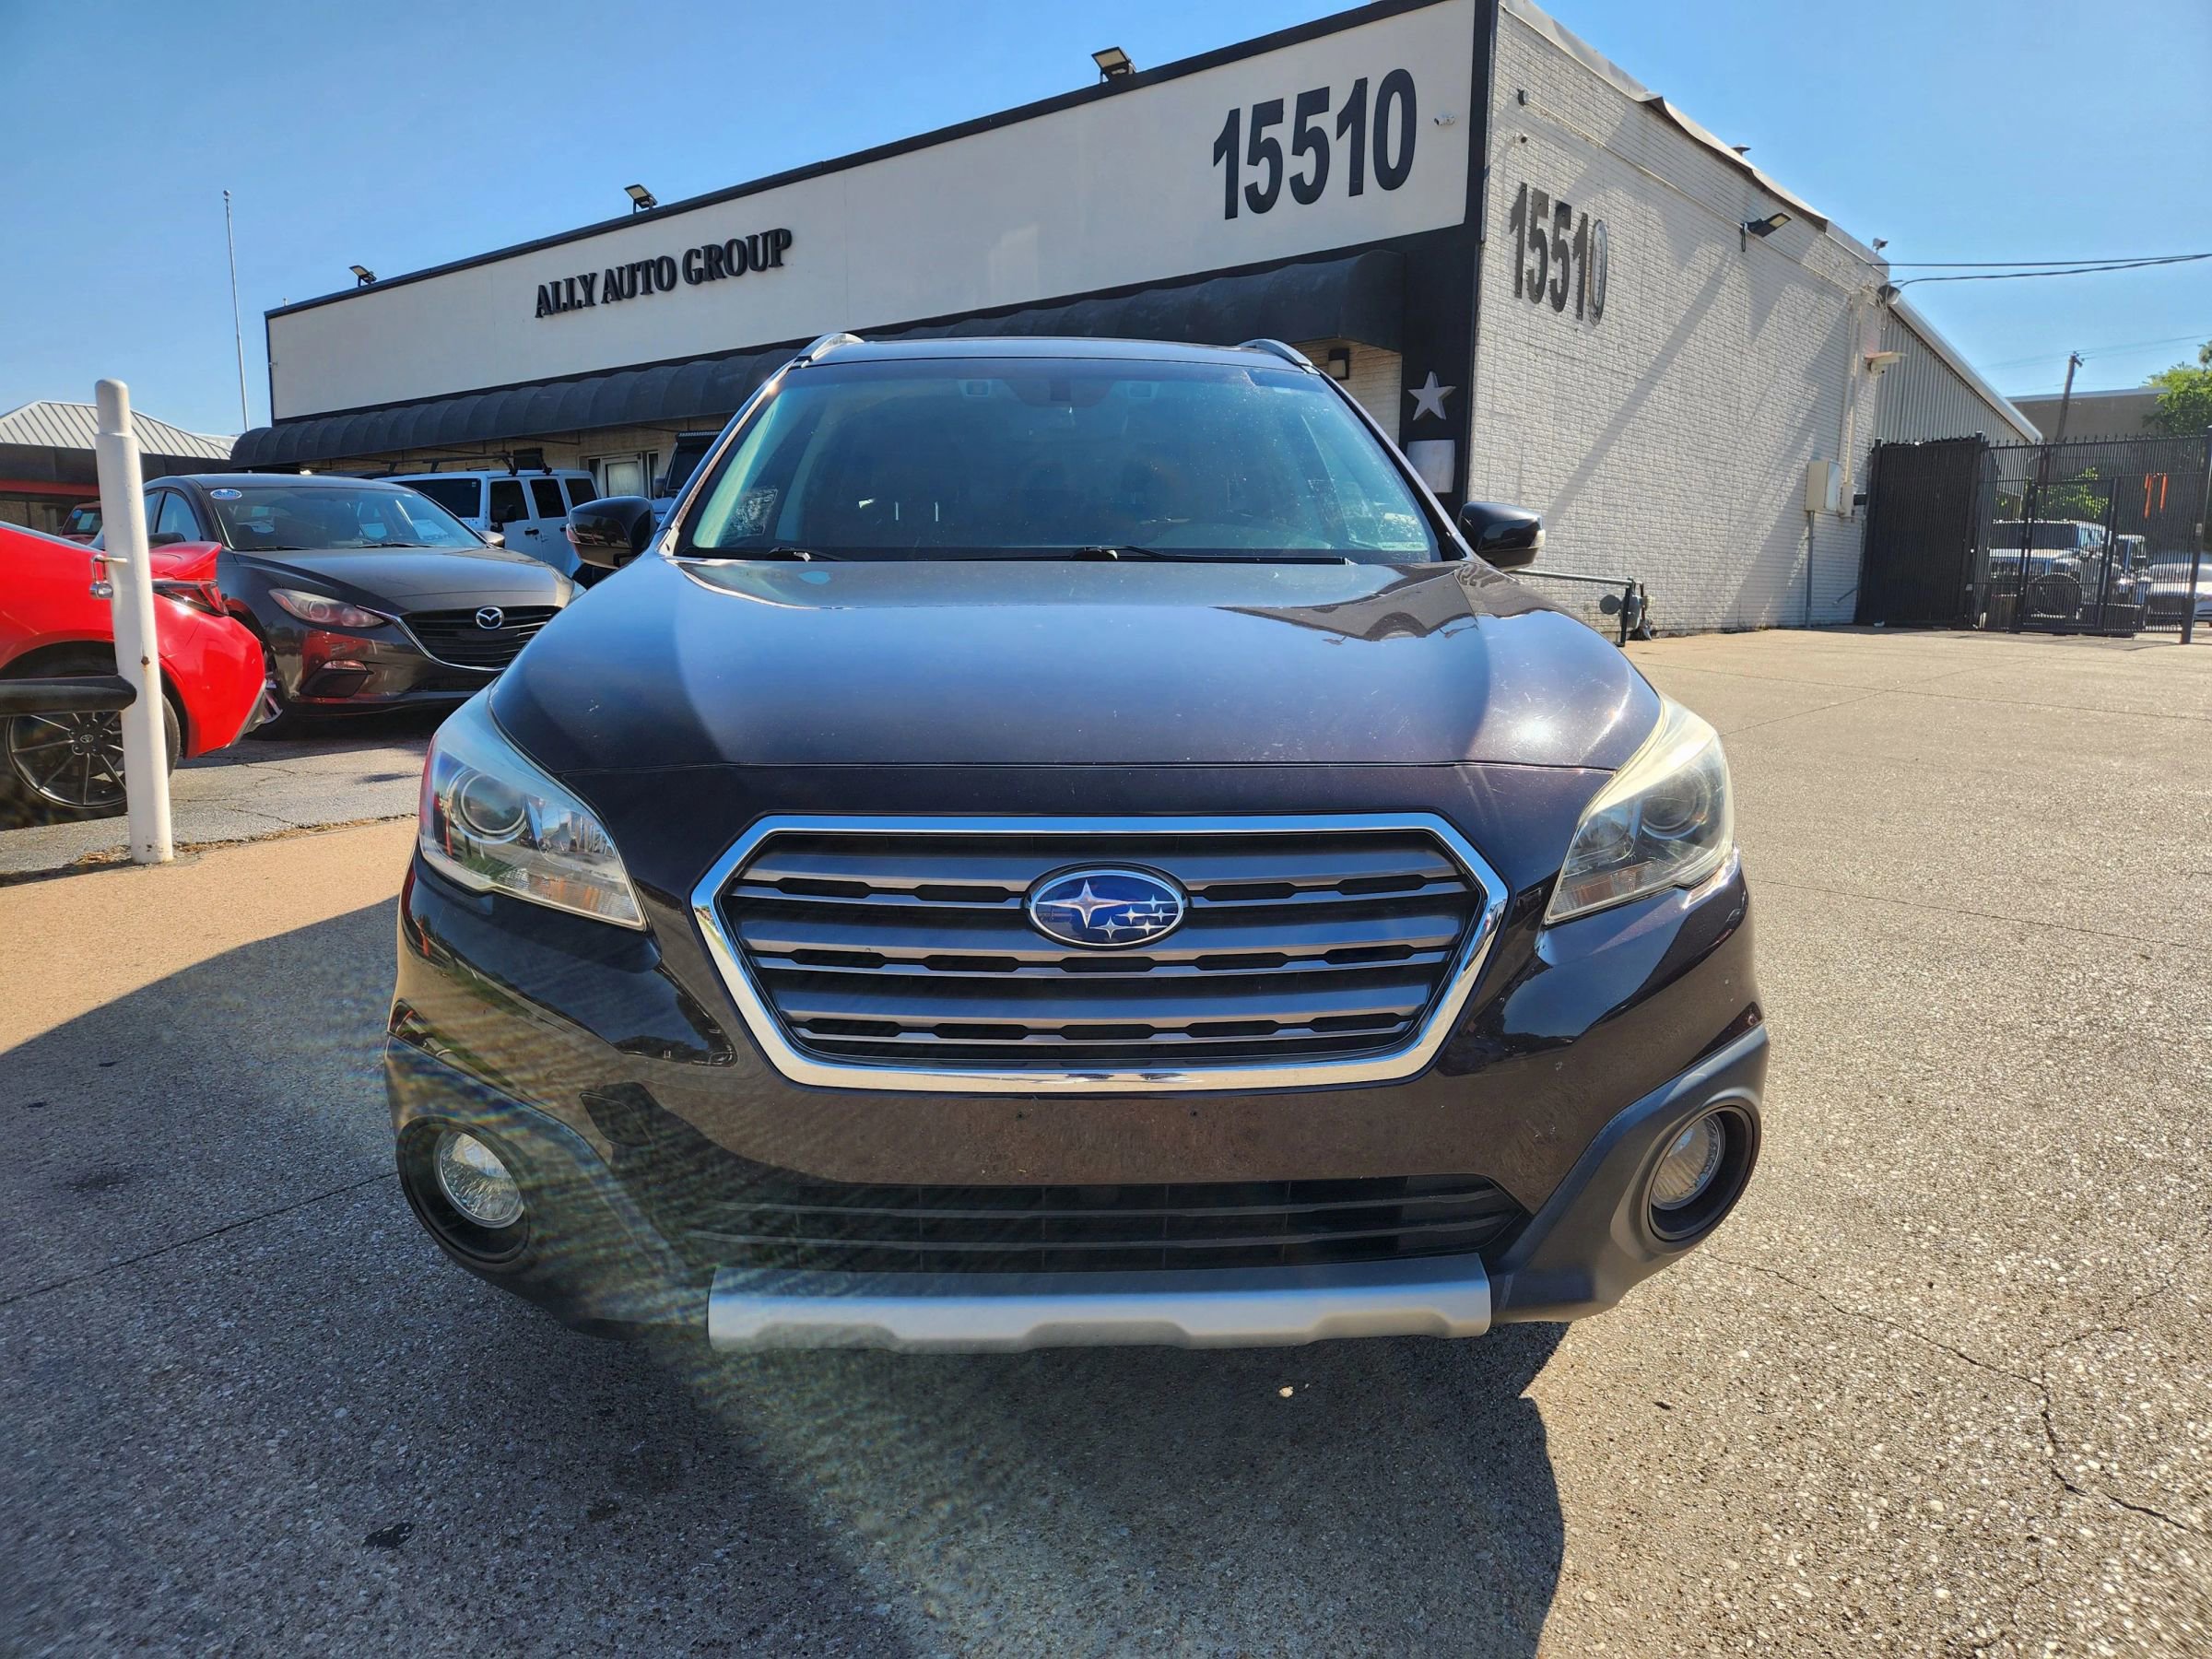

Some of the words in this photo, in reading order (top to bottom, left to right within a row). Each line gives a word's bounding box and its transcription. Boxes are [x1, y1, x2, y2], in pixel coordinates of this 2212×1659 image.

[1213, 68, 1417, 220] 15510
[535, 273, 597, 318] ALLY
[601, 255, 677, 304] AUTO
[682, 228, 793, 286] GROUP
[1509, 182, 1607, 326] 15510
